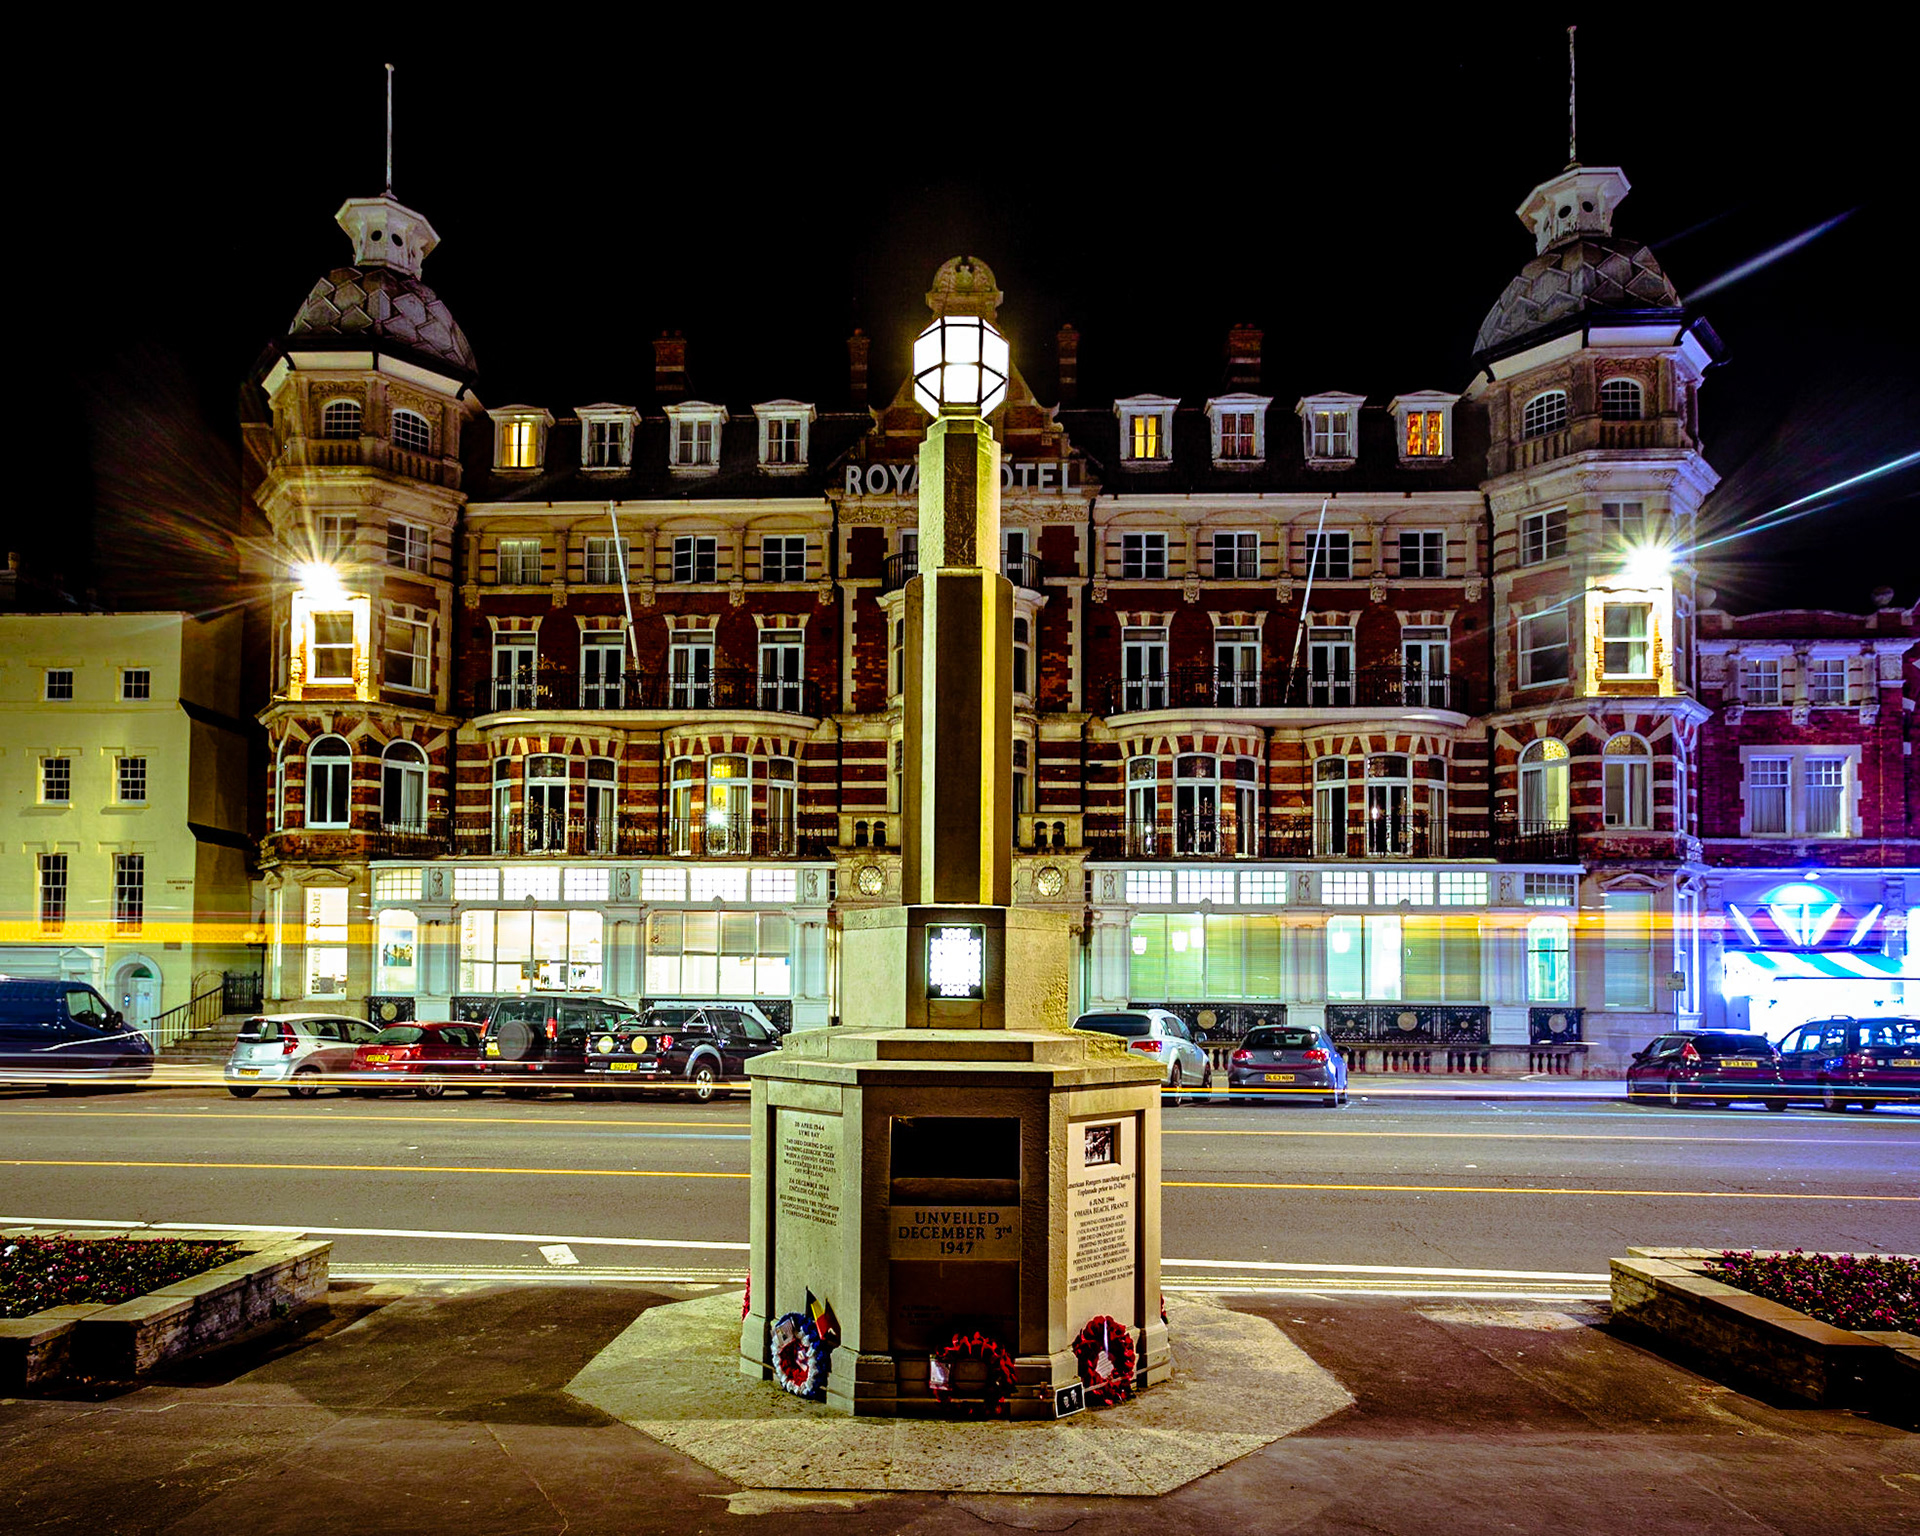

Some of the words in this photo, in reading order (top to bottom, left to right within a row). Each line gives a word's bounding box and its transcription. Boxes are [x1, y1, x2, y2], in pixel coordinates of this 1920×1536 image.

[845, 464, 919, 496] ROY
[1001, 463, 1081, 494] OTEL
[309, 892, 321, 914] bar
[915, 1211, 1000, 1225] UNVEILED
[898, 1226, 986, 1239] DECEMBER
[994, 1225, 1013, 1240] 3rd
[940, 1241, 974, 1254] 1947
